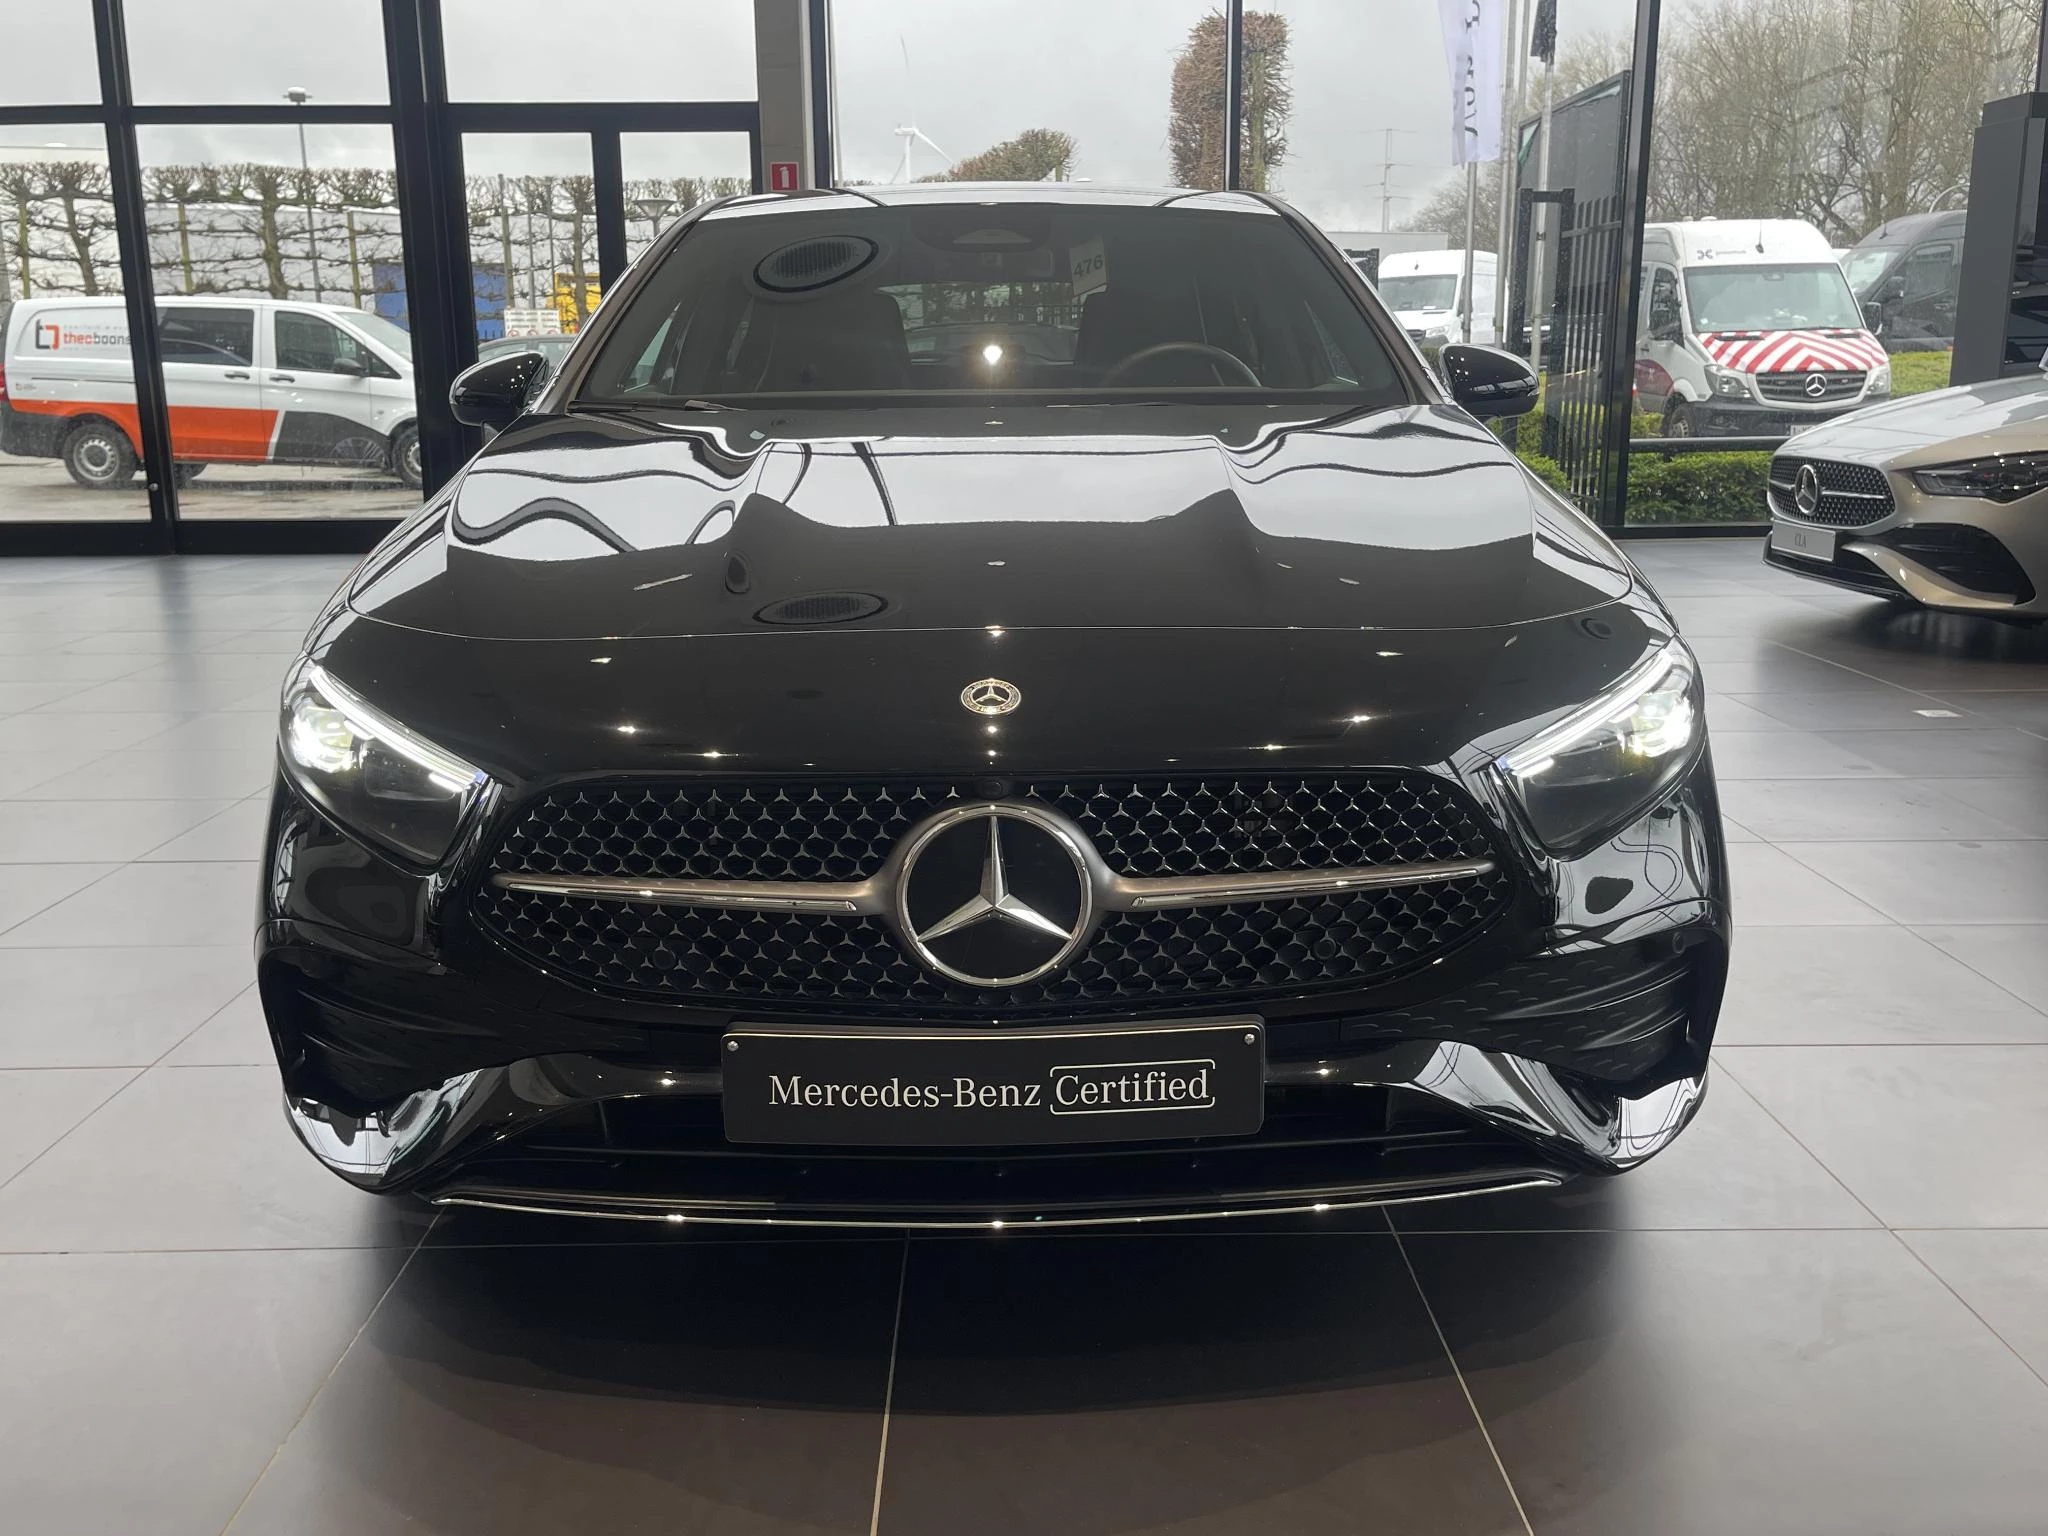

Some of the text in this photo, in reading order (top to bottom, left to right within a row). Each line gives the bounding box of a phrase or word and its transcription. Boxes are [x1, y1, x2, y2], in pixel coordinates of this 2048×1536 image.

[1073, 254, 1104, 277] 476
[768, 1068, 1210, 1108] Mercedes-Benz Certified
